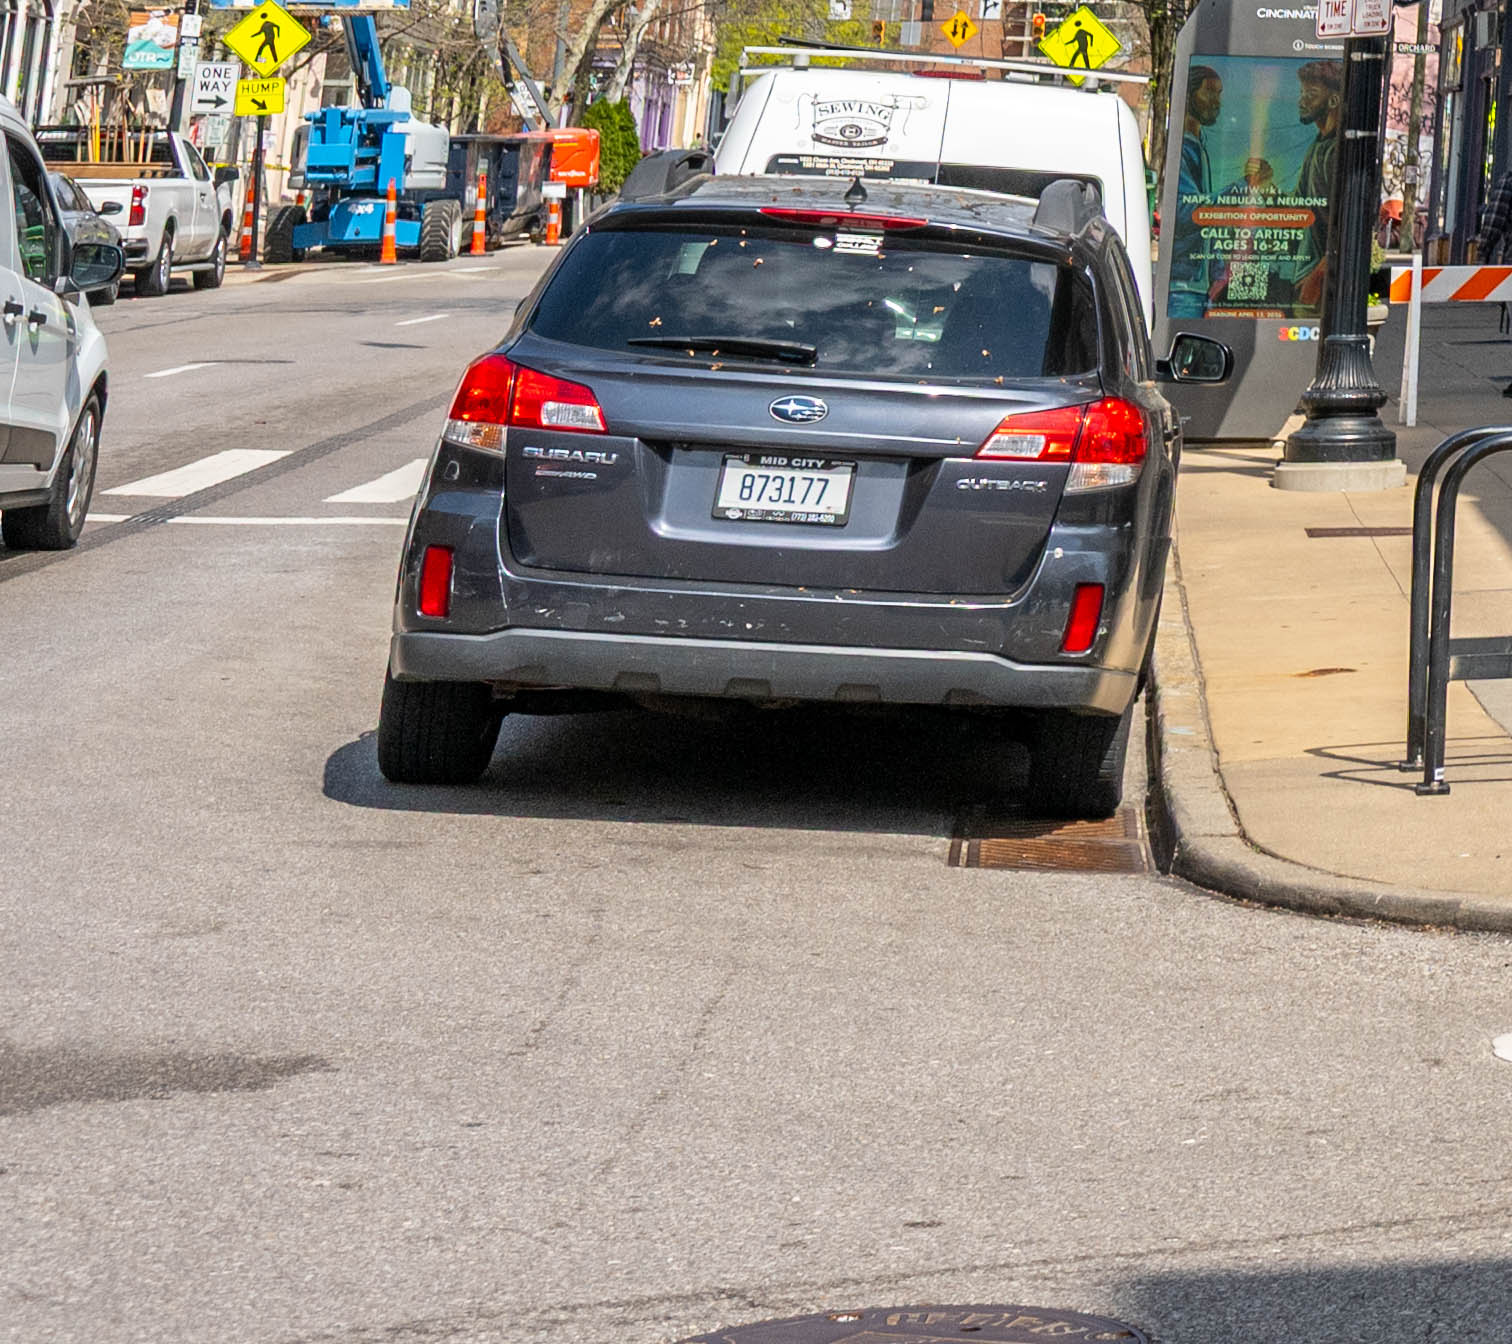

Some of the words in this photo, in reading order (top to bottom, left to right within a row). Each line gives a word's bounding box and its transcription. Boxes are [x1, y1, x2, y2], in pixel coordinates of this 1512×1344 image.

[1325, 0, 1347, 18] TIME
[1398, 44, 1436, 52] ORCHARD
[202, 67, 232, 79] ONE
[199, 81, 231, 93] WAY
[241, 82, 280, 94] HUMP
[818, 102, 891, 121] SEWING
[1182, 195, 1214, 205] NAPS,
[1217, 195, 1263, 206] NEBULAS
[1265, 196, 1274, 206] &
[1277, 196, 1328, 207] NEURONS
[1199, 212, 1247, 221] EXHIBITION
[1249, 213, 1309, 222] OPPORTUNITY
[1200, 228, 1230, 239] CALL
[1234, 228, 1251, 240] TO
[1255, 229, 1304, 240] ARTISTS
[1213, 240, 1247, 250] AGES
[1253, 240, 1288, 251] 16-24
[1278, 327, 1320, 341] 3CDC
[522, 446, 618, 465] SUBARU
[760, 455, 788, 465] MID
[791, 457, 826, 469] CITY
[739, 473, 830, 506] 873177
[956, 478, 1049, 493] OUTBACK
